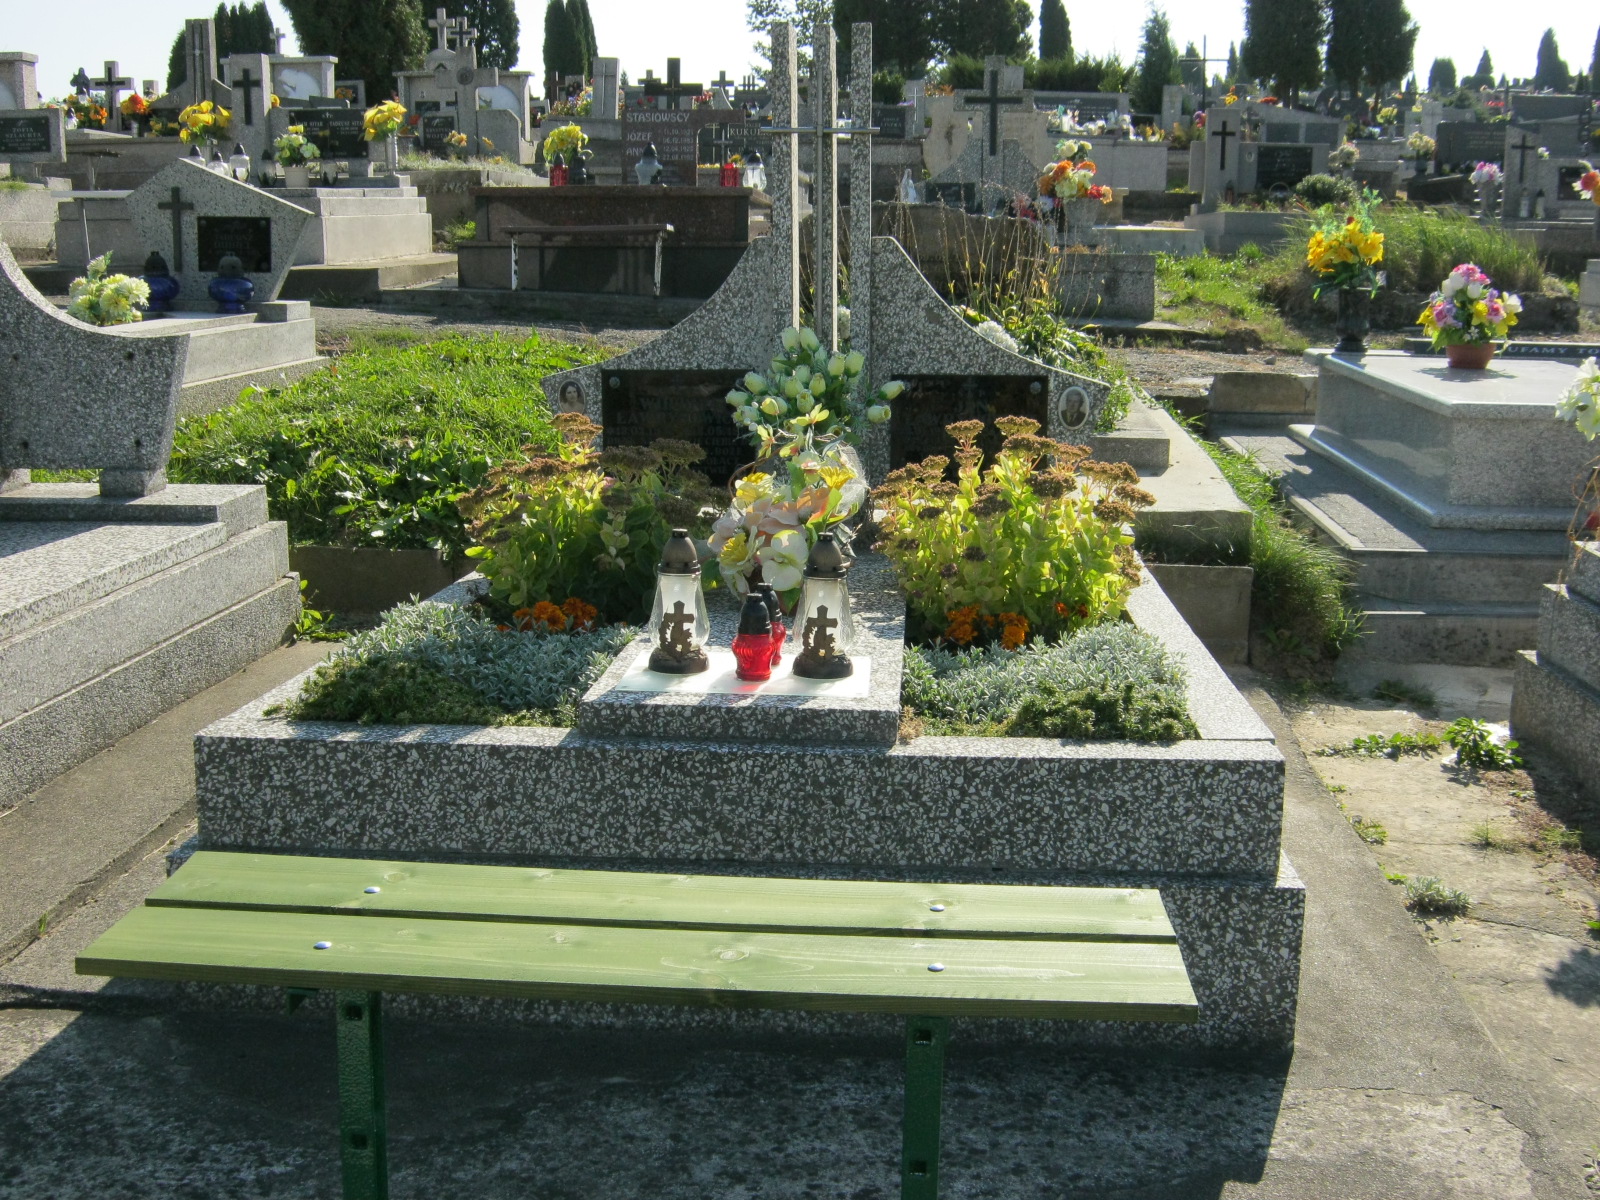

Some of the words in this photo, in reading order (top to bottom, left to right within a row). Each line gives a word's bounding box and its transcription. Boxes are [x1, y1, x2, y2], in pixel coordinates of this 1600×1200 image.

[626, 112, 690, 123] STASIOWSCY
[626, 129, 653, 141] JÓZEF
[626, 146, 645, 157] ANN
[1507, 346, 1569, 354] UFAMY
